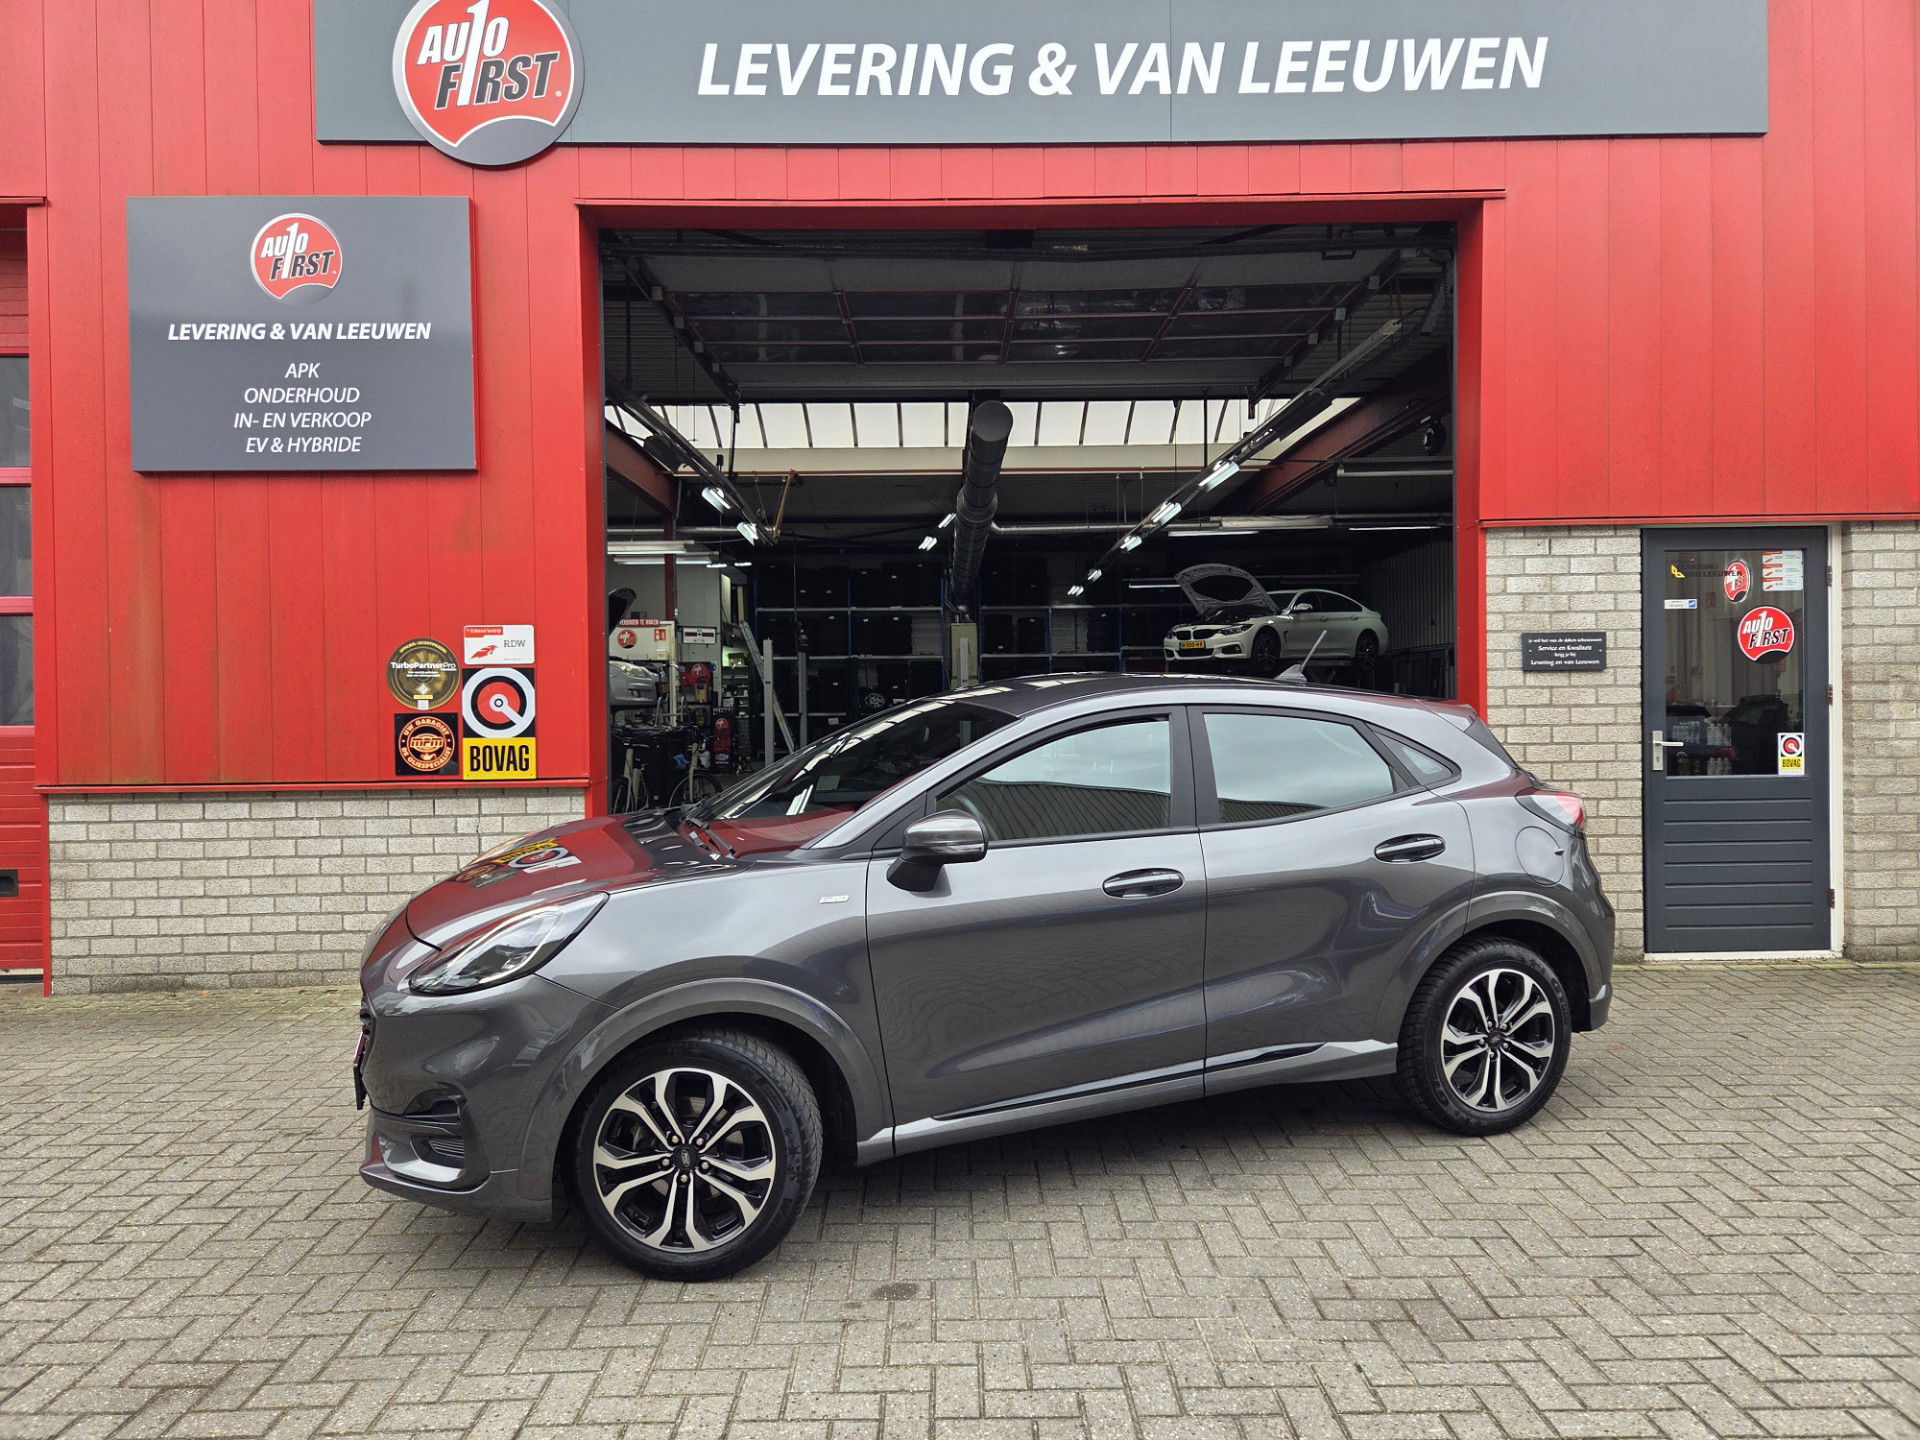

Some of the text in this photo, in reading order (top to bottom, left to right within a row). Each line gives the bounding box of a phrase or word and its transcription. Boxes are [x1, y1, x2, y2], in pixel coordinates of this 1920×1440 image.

[698, 37, 1548, 95] LEVERING & VAN LEEUWEN
[168, 323, 431, 340] LEVERING & VAN LEEUWEN
[285, 363, 320, 378] APK
[245, 388, 360, 403] ONDERHOUD
[234, 412, 371, 428] IN- EN VERKOOP
[246, 437, 362, 452] EV & HYBRIDE
[503, 640, 526, 648] RDW
[403, 723, 414, 736] UW
[469, 744, 530, 772] BOVAG
[1782, 758, 1801, 768] BOVAG
